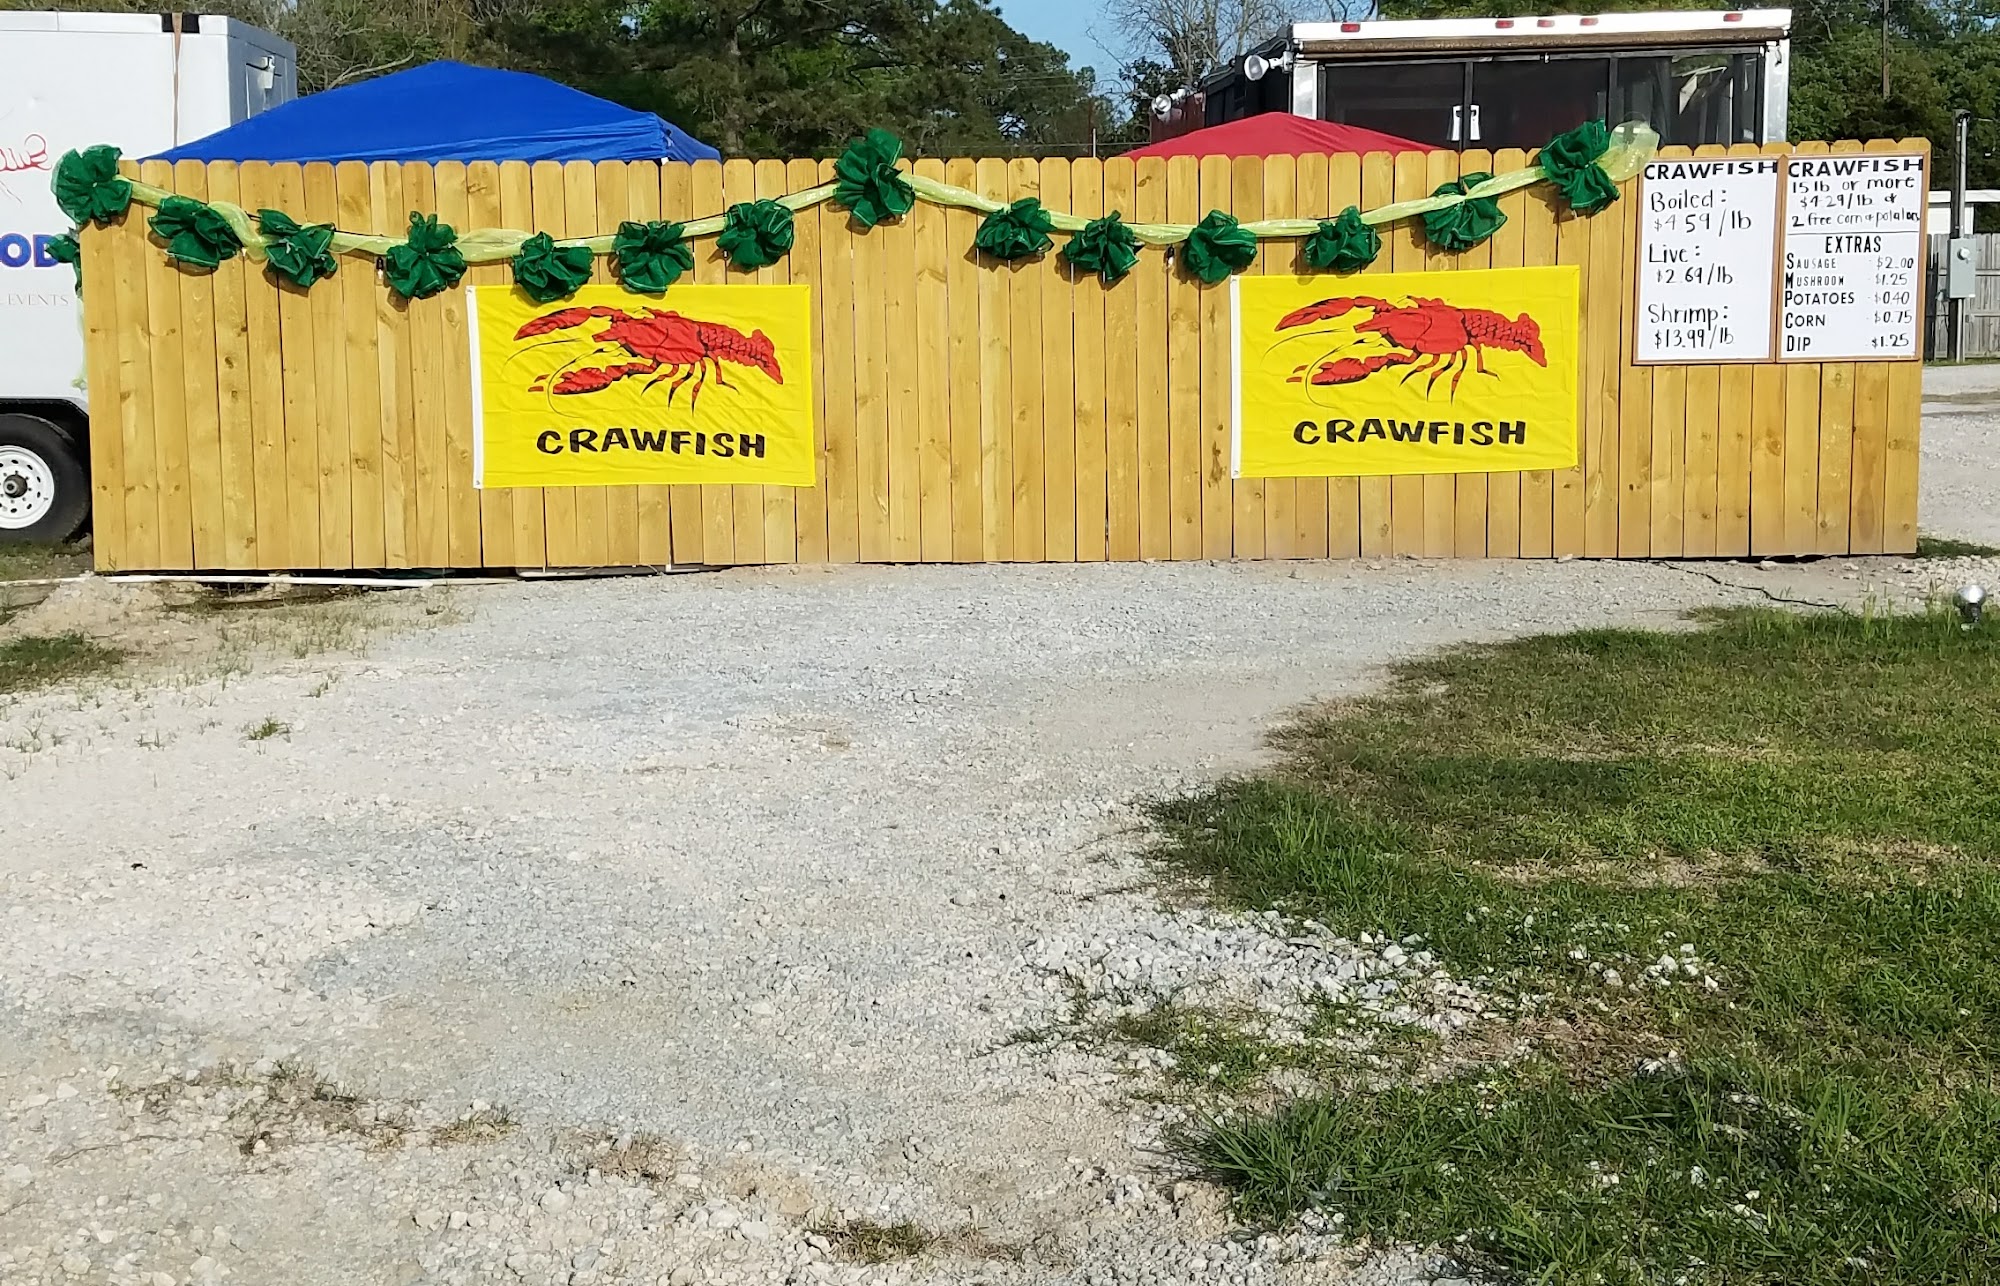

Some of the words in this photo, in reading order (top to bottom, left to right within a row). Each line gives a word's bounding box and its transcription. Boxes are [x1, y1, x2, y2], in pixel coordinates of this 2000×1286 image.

[1644, 162, 1777, 180] CRAWFISH
[1788, 159, 1923, 177] CRAWFISH
[1842, 181, 1859, 191] or
[1867, 177, 1915, 189] more
[1792, 216, 1804, 227] 2
[1808, 213, 1832, 225] free
[1826, 236, 1882, 254] EXTRAS
[1786, 253, 1836, 269] SAUSAGE
[1877, 256, 1914, 270] $2.00
[1785, 272, 1844, 289] MUSHROOM
[1875, 273, 1908, 286] $1.25
[8, 294, 69, 306] EVENTS
[1785, 291, 1854, 307] POTATOES
[1785, 312, 1826, 329] CORN
[1874, 310, 1912, 323] $0.75
[1655, 325, 1734, 349] $13.99/lb
[1787, 335, 1811, 352] DIP
[1871, 333, 1909, 349] $1.25
[1293, 419, 1527, 446] CRAWFISH
[536, 427, 766, 459] CRAWFISH
